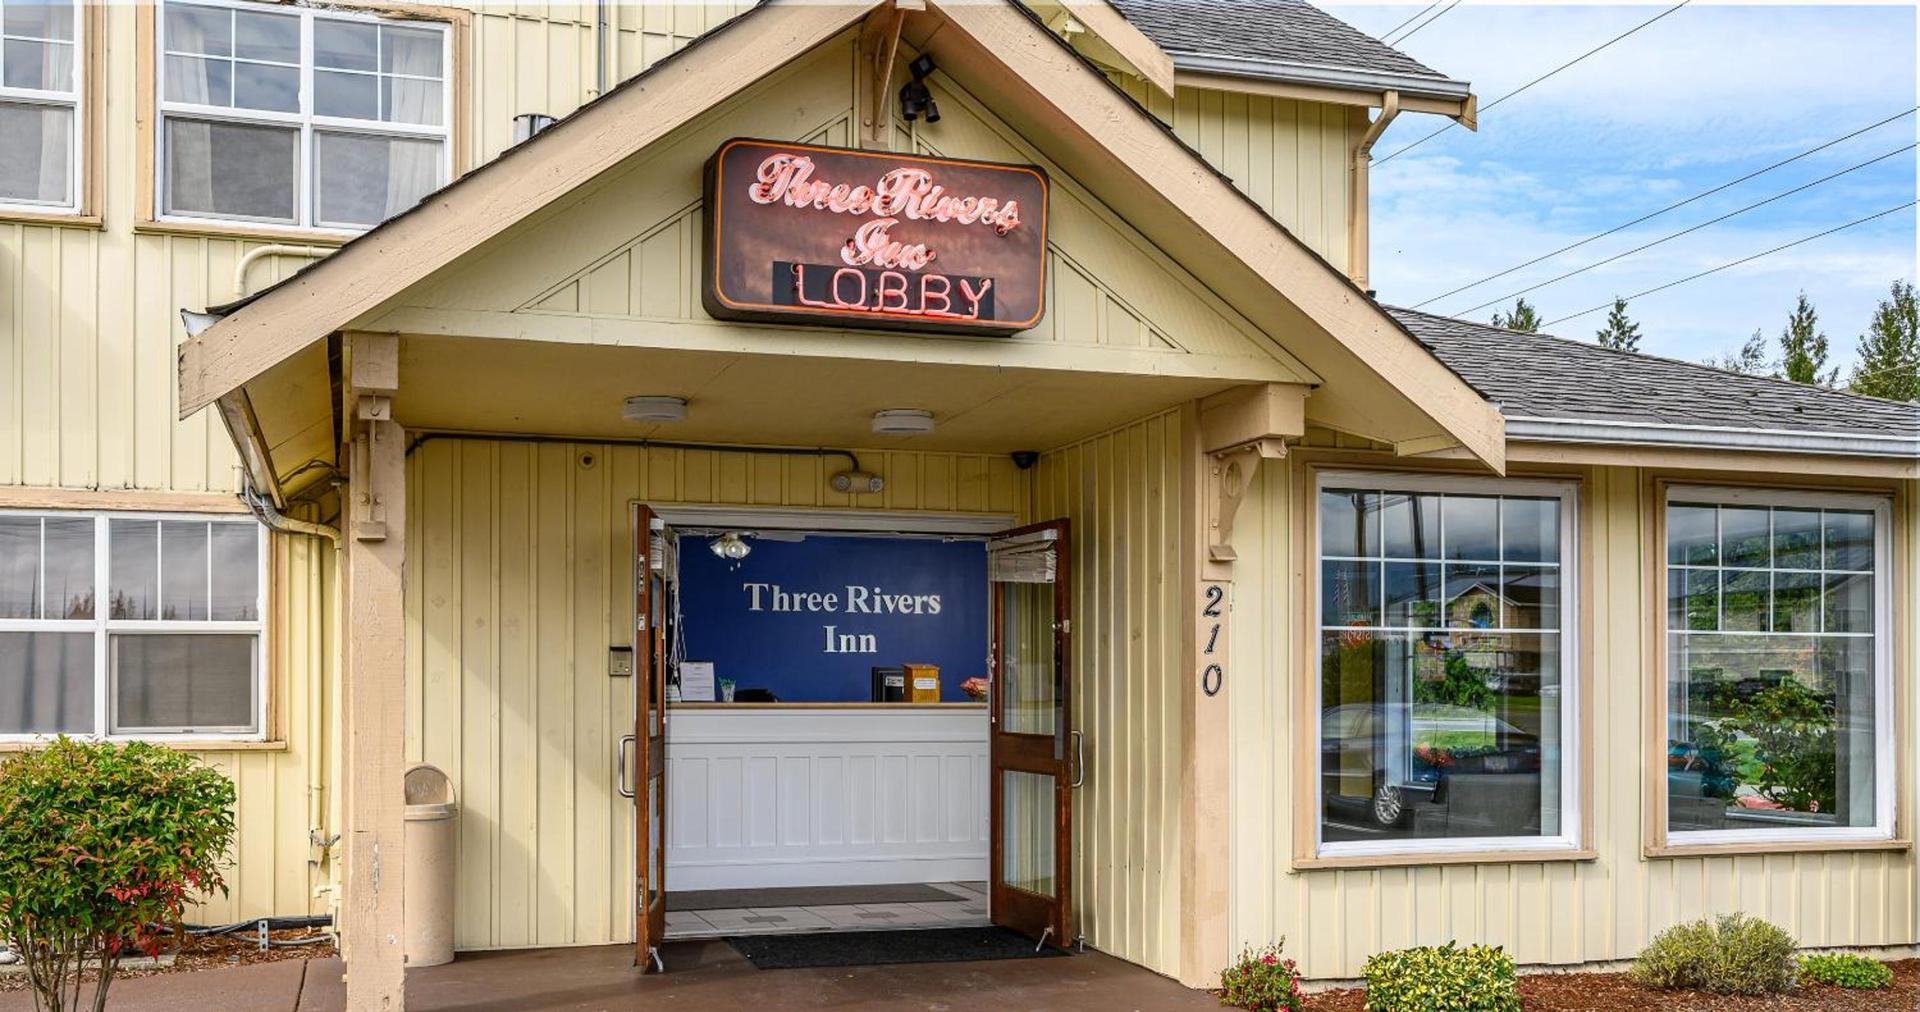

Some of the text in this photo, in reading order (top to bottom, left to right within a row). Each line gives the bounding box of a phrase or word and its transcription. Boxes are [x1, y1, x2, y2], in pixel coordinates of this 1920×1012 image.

[749, 153, 1021, 236] Three Rivers
[841, 218, 937, 271] Inn
[791, 264, 992, 320] LOBBY
[743, 583, 942, 615] Three Rivers
[823, 625, 878, 654] Inn
[1202, 585, 1223, 697] 210
